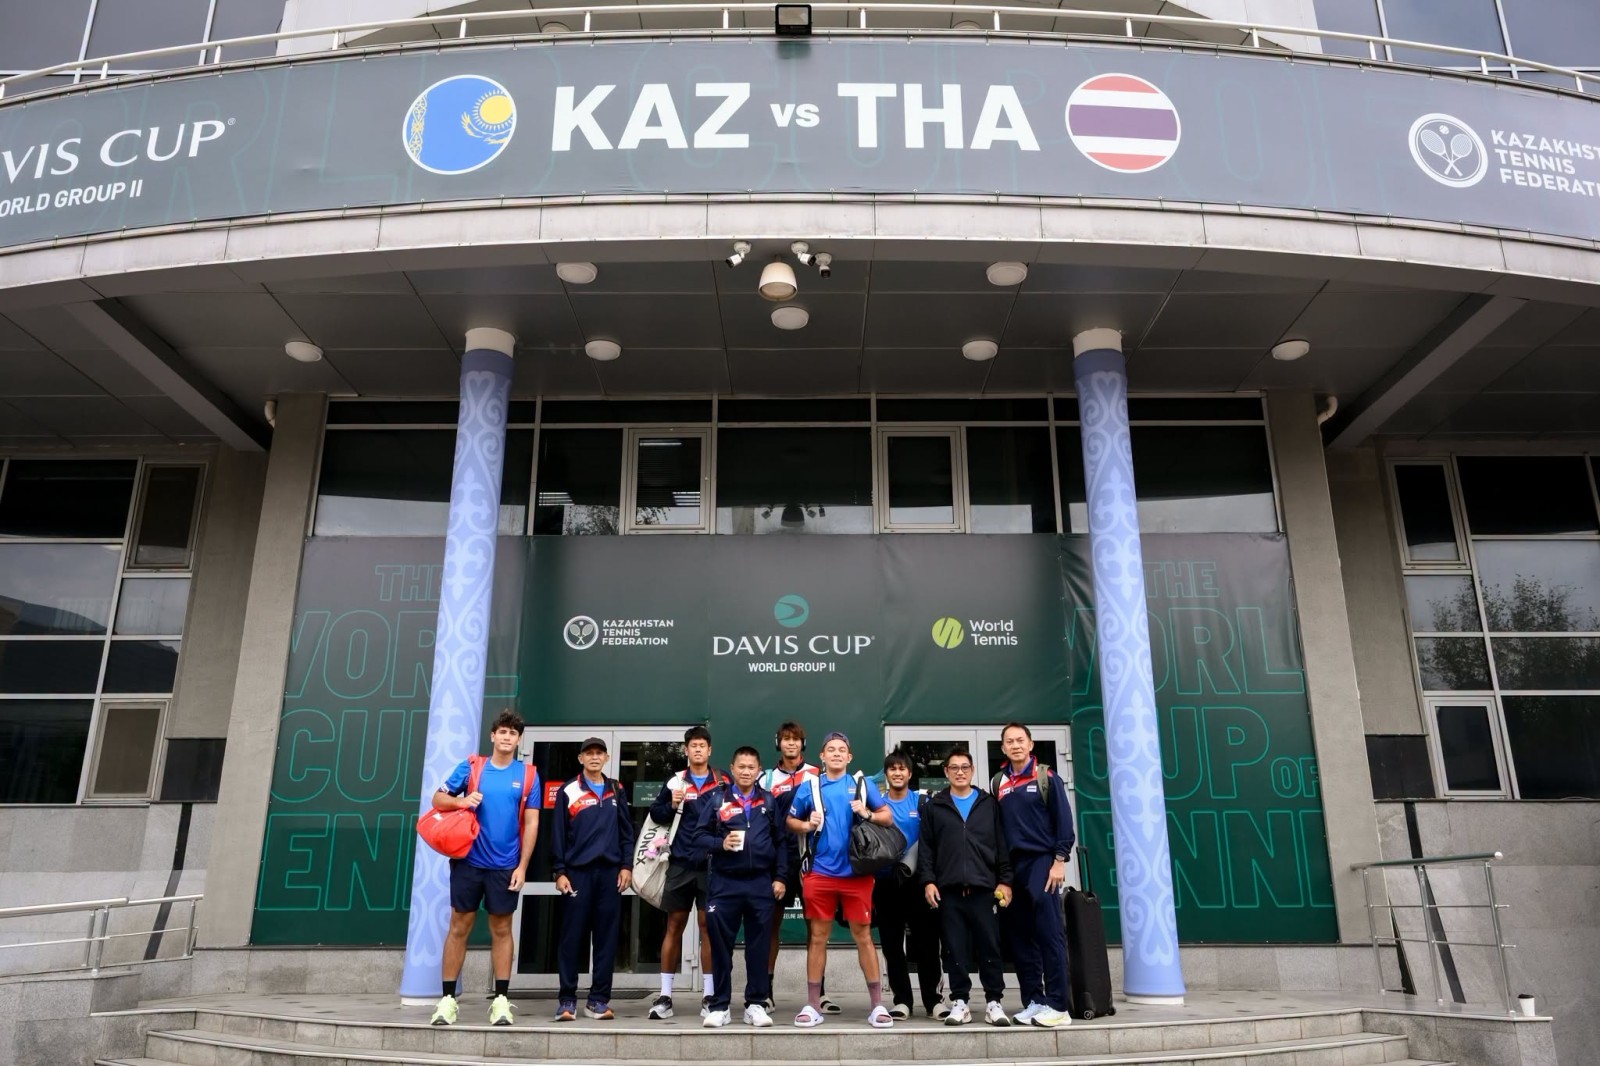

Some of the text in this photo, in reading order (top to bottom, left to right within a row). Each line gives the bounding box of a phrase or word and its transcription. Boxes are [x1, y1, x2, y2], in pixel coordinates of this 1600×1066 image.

[551, 82, 751, 152] KAZ
[837, 82, 1041, 152] THA
[3, 137, 82, 184] VIS
[1494, 148, 1576, 175] TENNIS
[54, 181, 126, 208] GROUP
[129, 179, 144, 198] II
[602, 619, 674, 628] KAZAKHSTAN
[968, 619, 1014, 632] World
[602, 628, 641, 637] TENNIS
[970, 632, 1018, 646] Tennis
[601, 637, 669, 646] FEDERATION
[712, 635, 800, 656] DAVIS
[748, 662, 836, 673] WORLD GROUP II
[635, 825, 660, 866] YONEX
